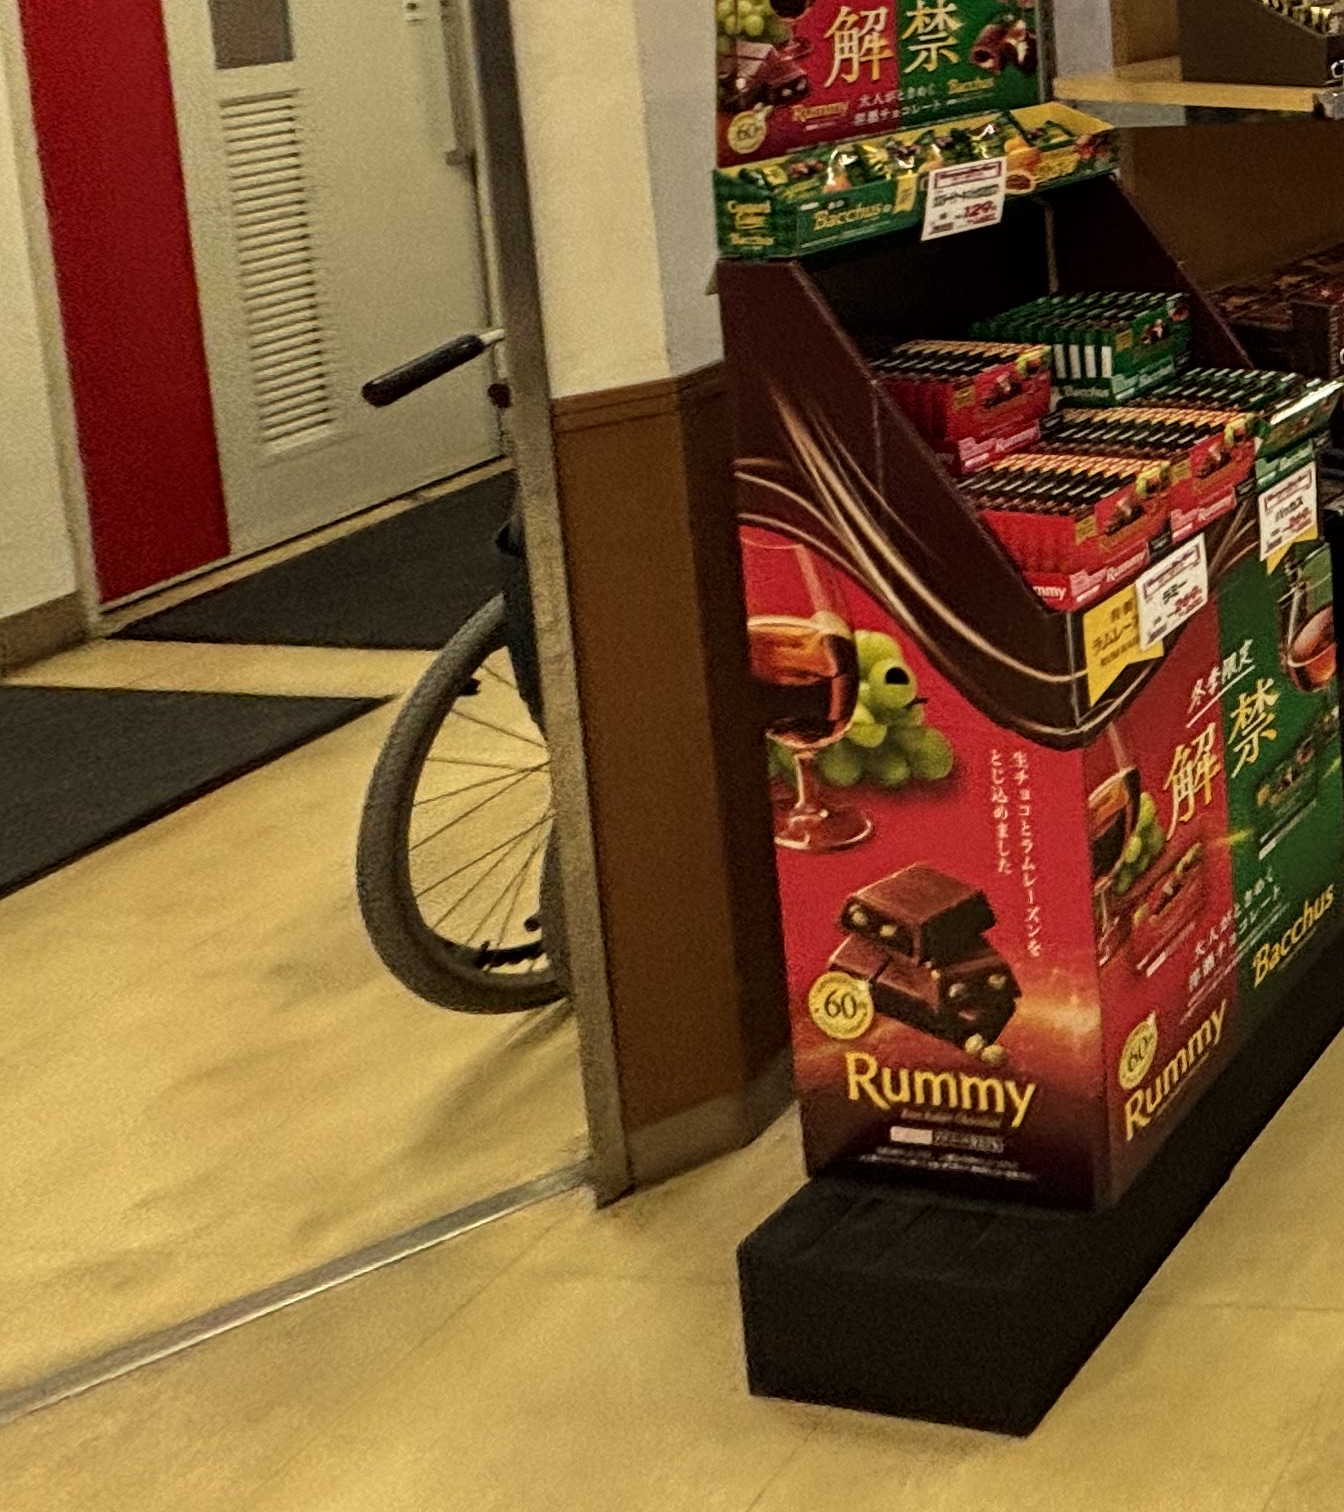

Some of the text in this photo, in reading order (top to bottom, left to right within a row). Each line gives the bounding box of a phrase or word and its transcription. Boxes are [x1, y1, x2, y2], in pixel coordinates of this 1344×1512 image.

[853, 99, 942, 126] チョコレート
[1032, 584, 1067, 601] mmy
[1091, 621, 1134, 655] ラムレー
[1163, 677, 1281, 841] 解禁
[990, 749, 1013, 876] とじ込めました
[1012, 750, 1041, 958] 生チョコとラムレーズンを
[1188, 884, 1281, 992] チョコレート
[1252, 883, 1335, 988] Bacchus
[824, 989, 858, 1020] 60
[845, 1050, 1037, 1128] Rummy
[1124, 998, 1227, 1142] Rummy
